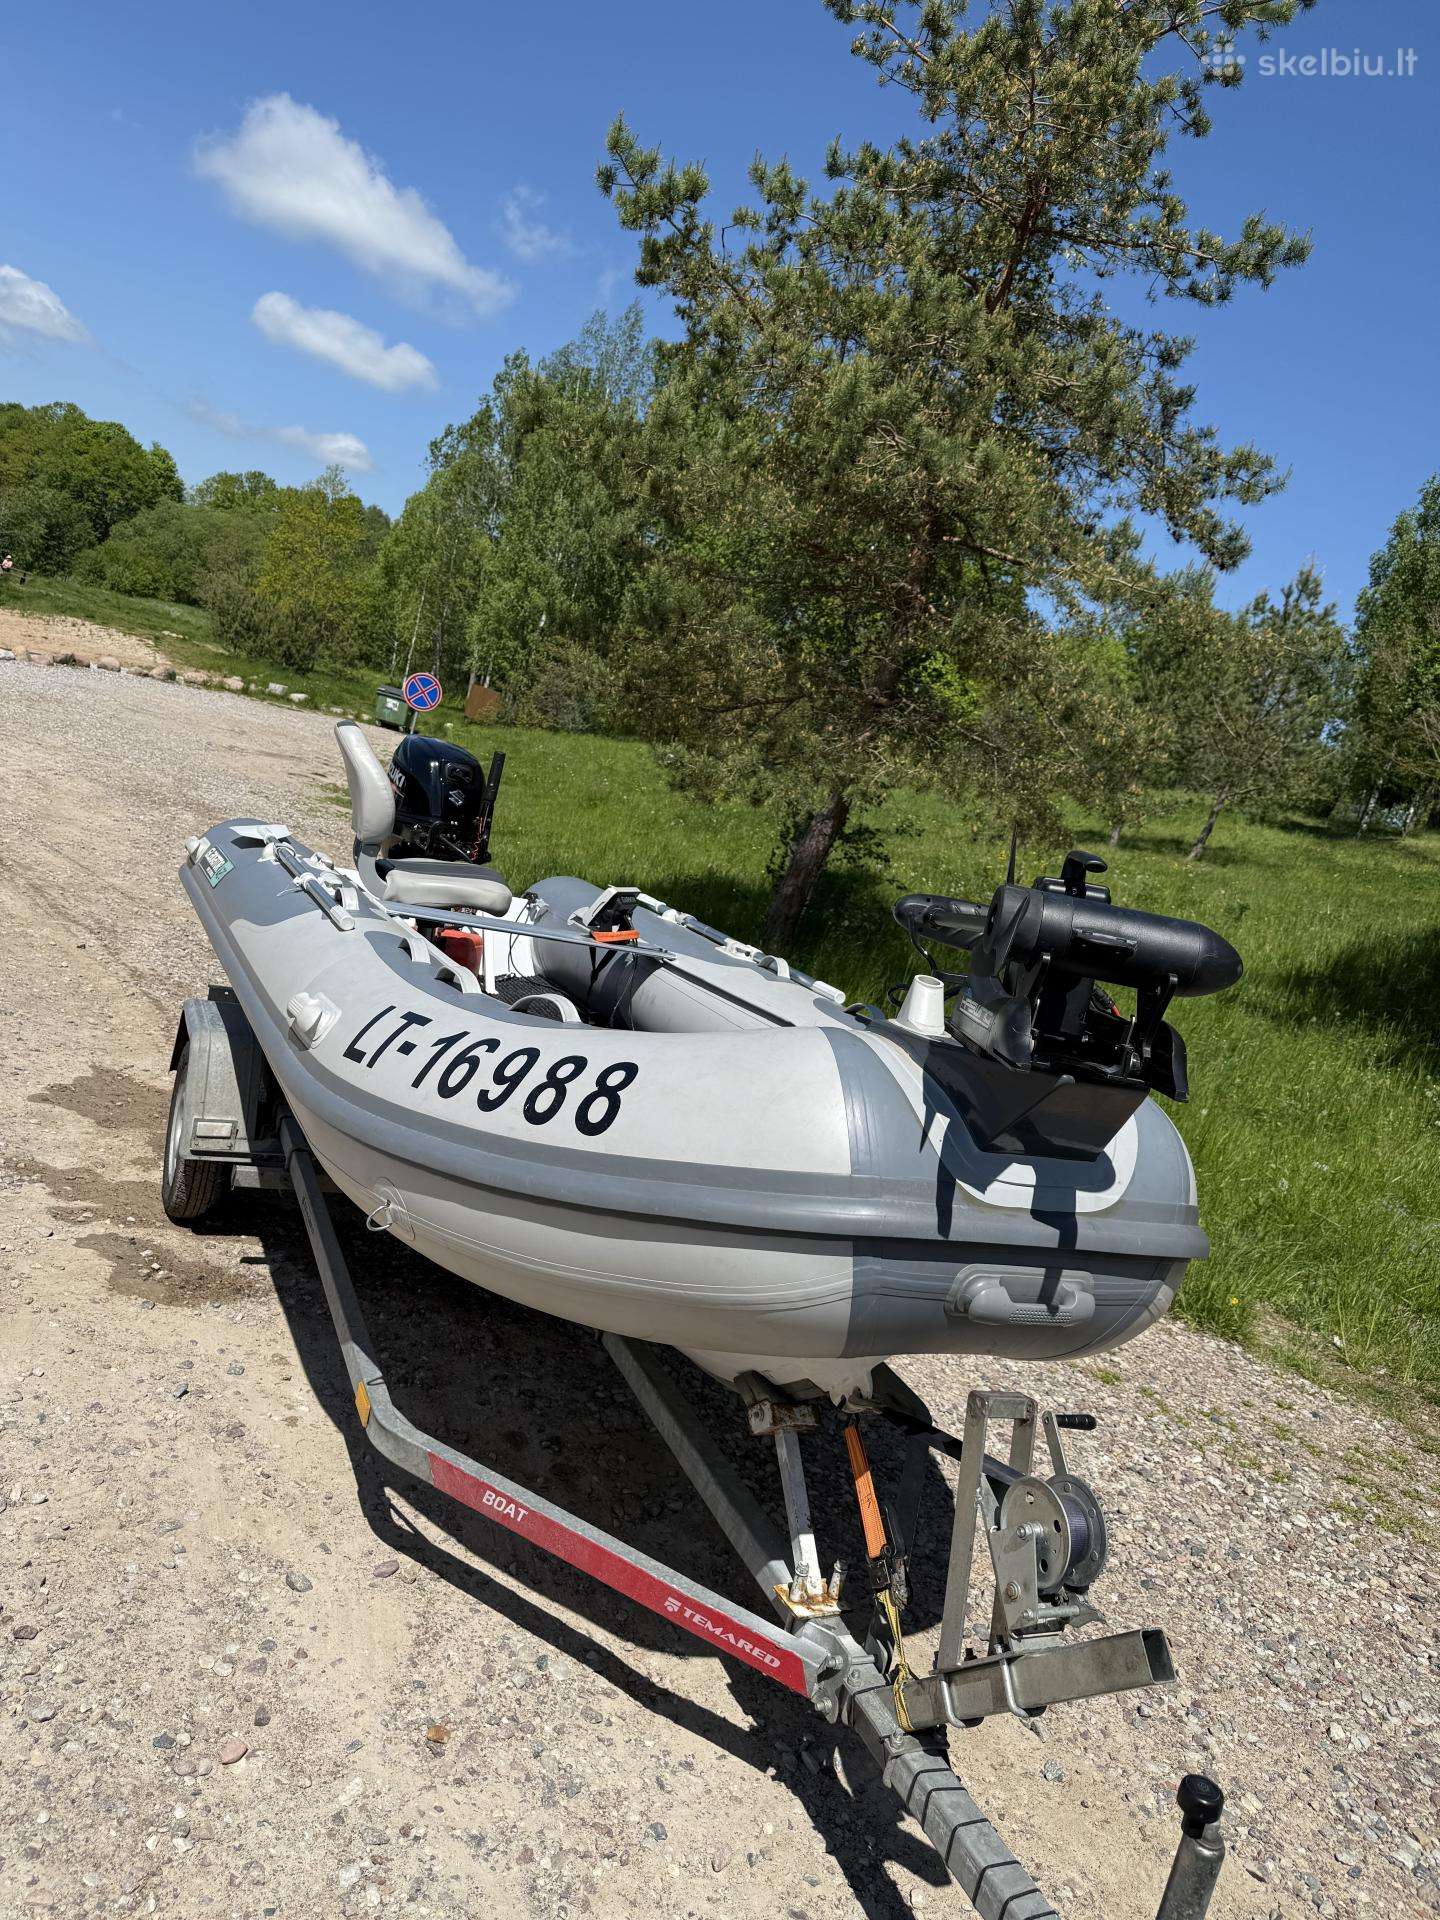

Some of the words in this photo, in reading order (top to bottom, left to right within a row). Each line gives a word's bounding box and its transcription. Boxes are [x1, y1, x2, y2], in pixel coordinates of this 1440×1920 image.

[342, 1005, 639, 1136] LT-16988
[482, 1490, 529, 1523] BOAT
[683, 1607, 781, 1668] TEMARED
